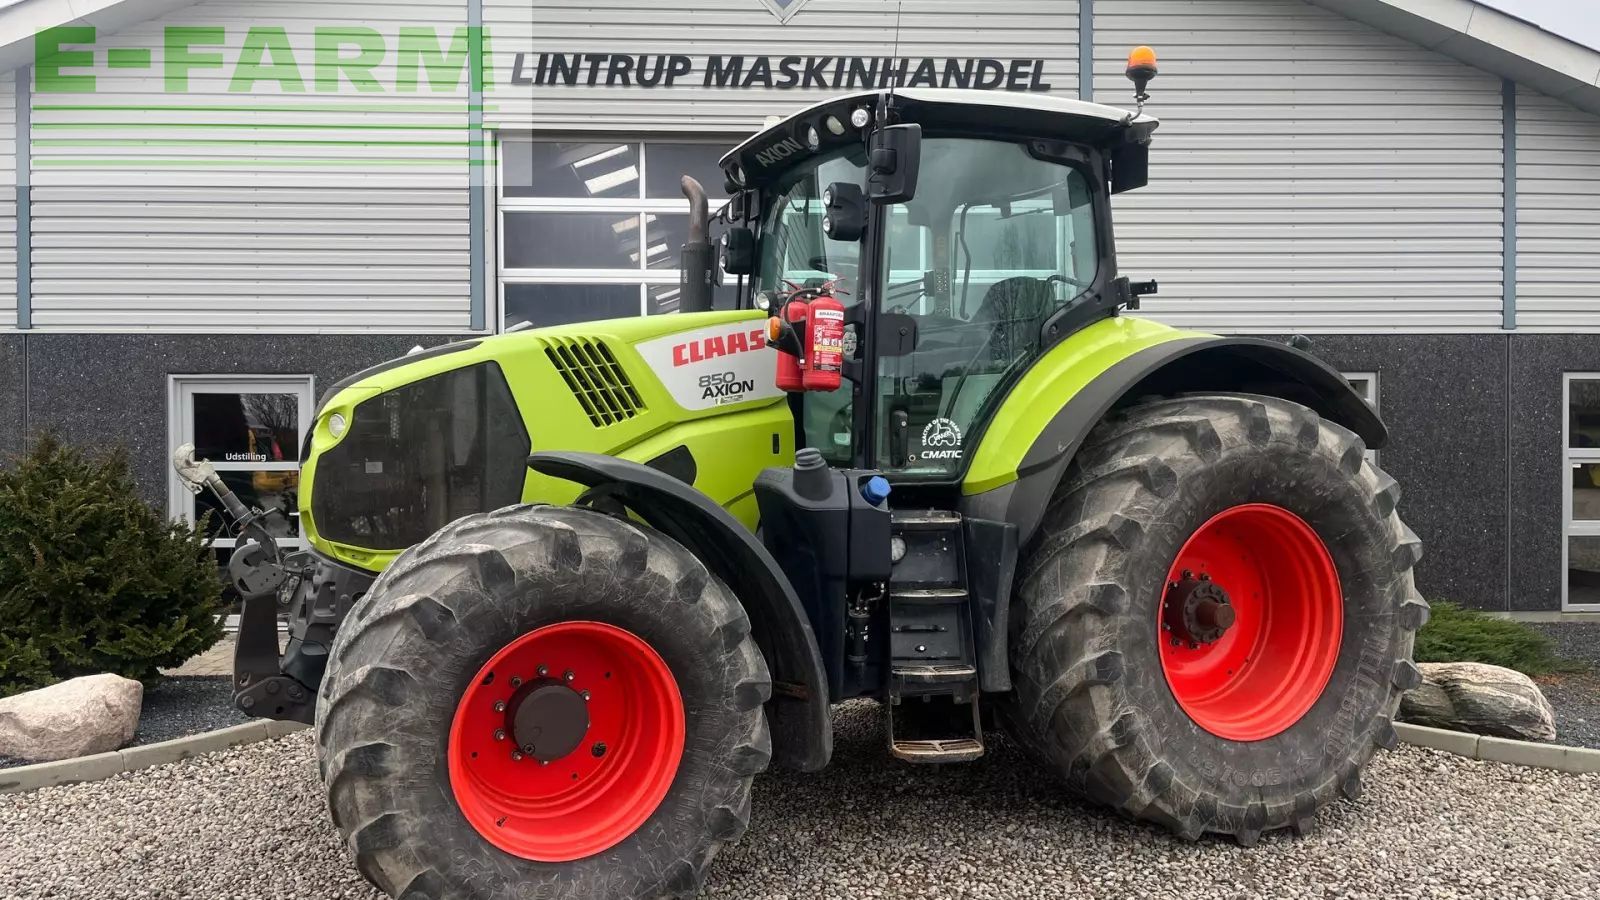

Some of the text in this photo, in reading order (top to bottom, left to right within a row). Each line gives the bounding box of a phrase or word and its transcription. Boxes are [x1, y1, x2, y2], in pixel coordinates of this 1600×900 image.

[511, 53, 1051, 90] LINTRUP MASKINHANDEL
[755, 136, 804, 167] AXION
[672, 329, 765, 368] CLAAS
[698, 371, 736, 388] 850
[701, 379, 754, 400] AXION
[225, 453, 267, 462] Udstilling
[921, 450, 963, 458] CMATIC
